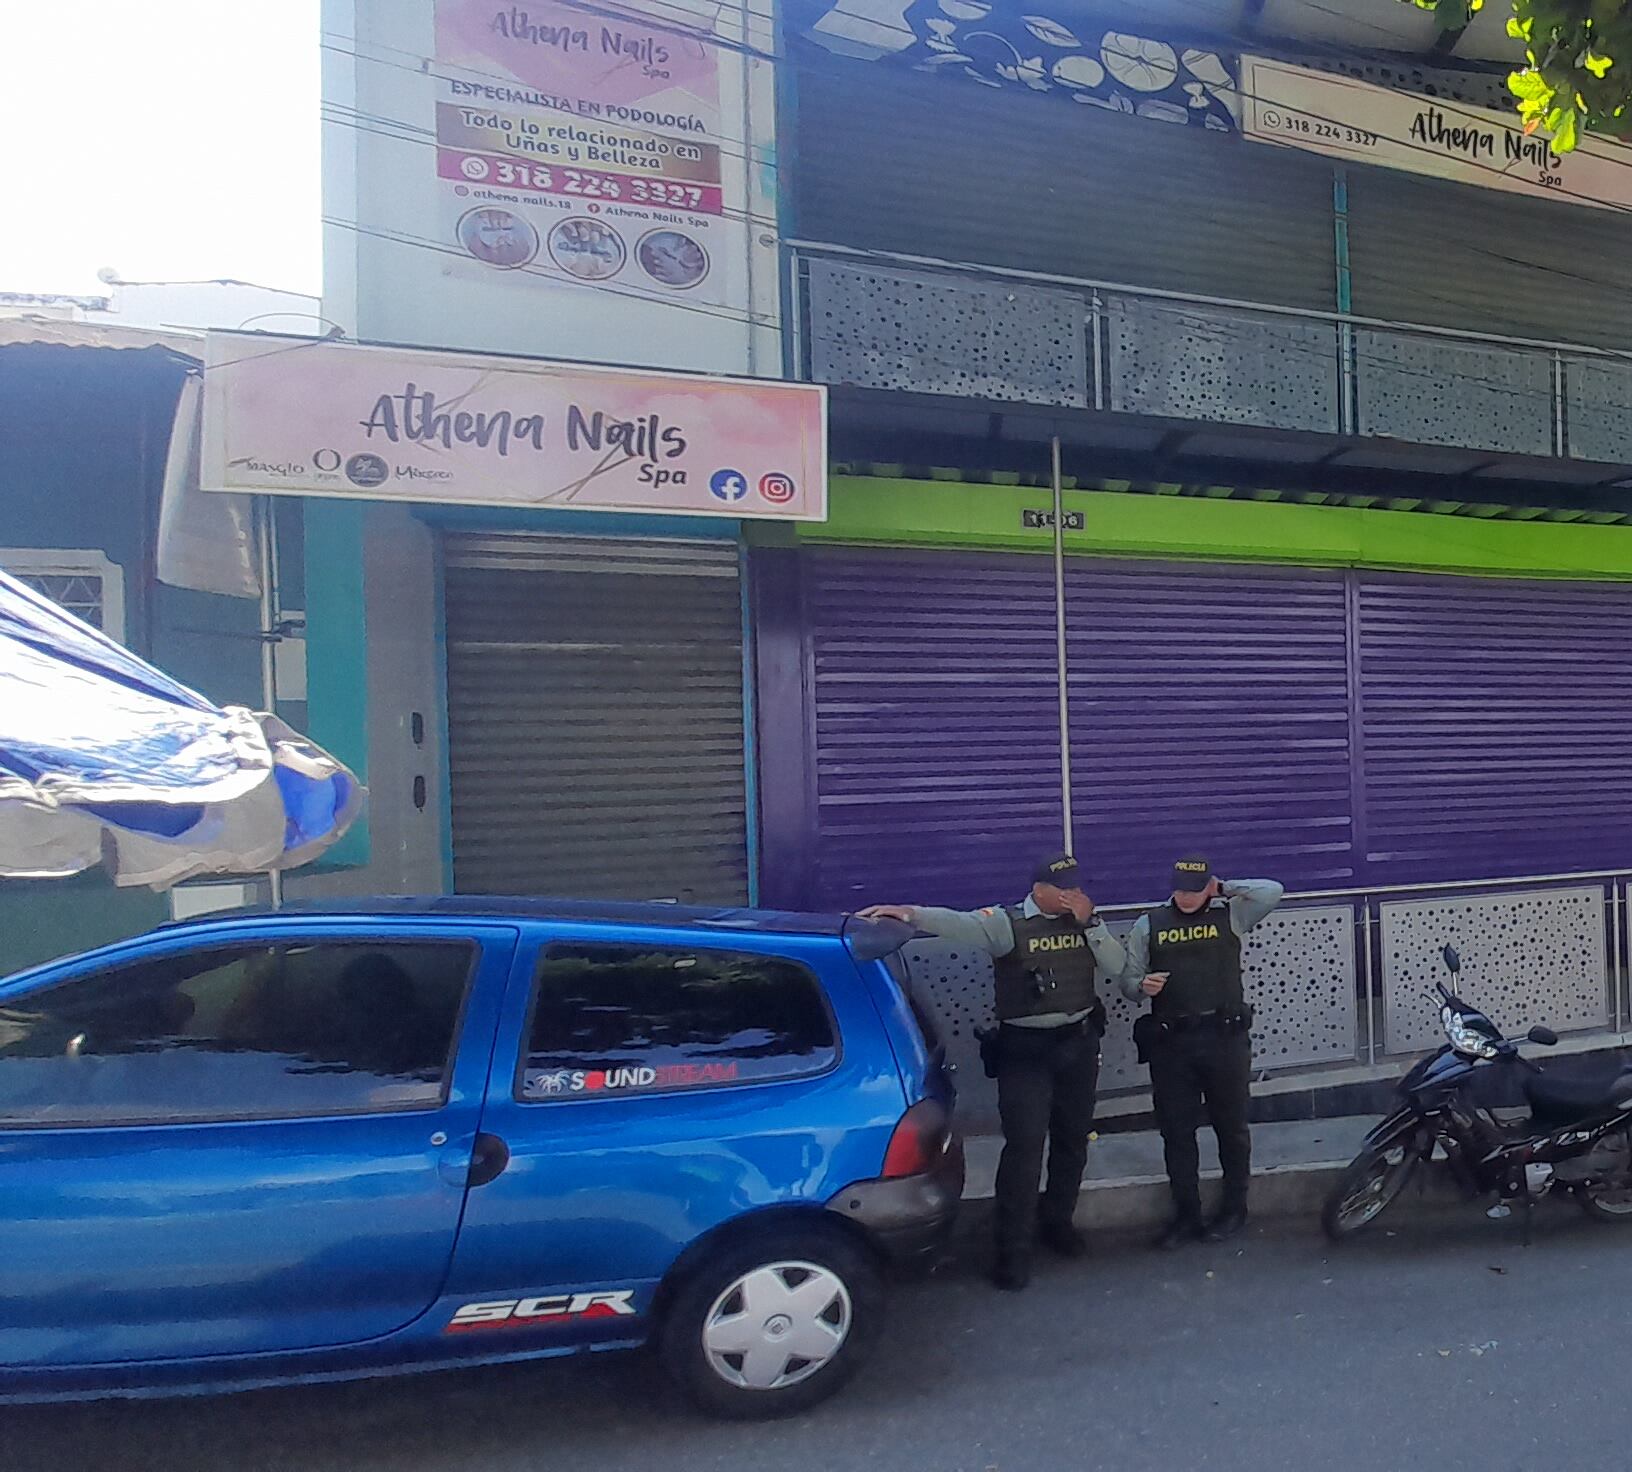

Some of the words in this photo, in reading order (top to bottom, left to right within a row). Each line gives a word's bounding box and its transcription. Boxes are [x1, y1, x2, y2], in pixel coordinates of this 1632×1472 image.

[492, 7, 588, 52] Athena
[601, 27, 670, 65] Nails
[641, 64, 671, 80] Spa
[451, 79, 573, 112] ESPECIALISTA
[578, 99, 601, 115] EN
[606, 103, 706, 134] PODOLOGÍA
[461, 110, 513, 132] Todo
[520, 118, 540, 135] lo
[548, 123, 670, 155] relacionado
[675, 146, 700, 160] en
[505, 131, 560, 155] Uñas
[567, 146, 580, 161] y
[587, 145, 661, 170] Belleza
[1285, 117, 1310, 133] 318
[1315, 123, 1341, 140] 224
[1346, 129, 1378, 147] 3327
[1408, 107, 1494, 159] Athena
[495, 160, 553, 188] 318
[563, 169, 622, 200] 224
[631, 179, 703, 209] 3327
[1538, 170, 1563, 187] Spa
[605, 206, 650, 220] Athena
[652, 212, 684, 226] Nails
[687, 215, 710, 229] Spa
[360, 382, 545, 456] Athena
[567, 405, 687, 463] Nails
[637, 463, 688, 490] Spa
[1029, 934, 1086, 953] POLICIA
[1158, 925, 1219, 945] POLICIA
[450, 1289, 637, 1326] SCR
